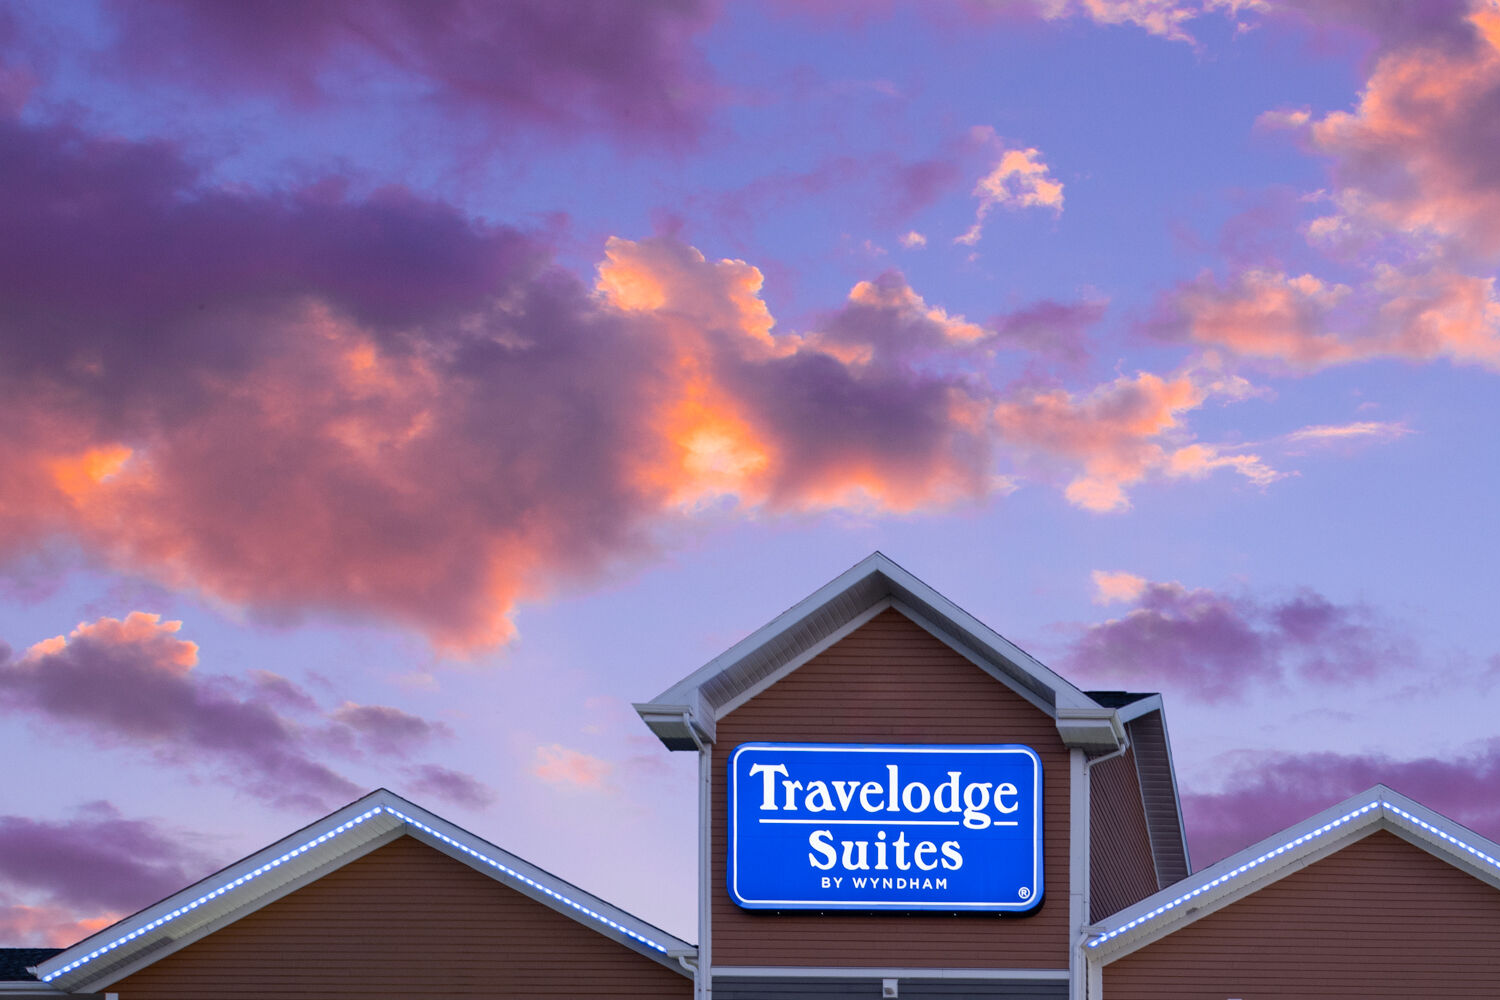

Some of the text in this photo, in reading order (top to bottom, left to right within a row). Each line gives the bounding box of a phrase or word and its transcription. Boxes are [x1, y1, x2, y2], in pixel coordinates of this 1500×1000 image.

[749, 762, 1019, 830] Travelodge
[808, 829, 964, 871] Suites
[821, 876, 947, 890] BY WYNDHAM
